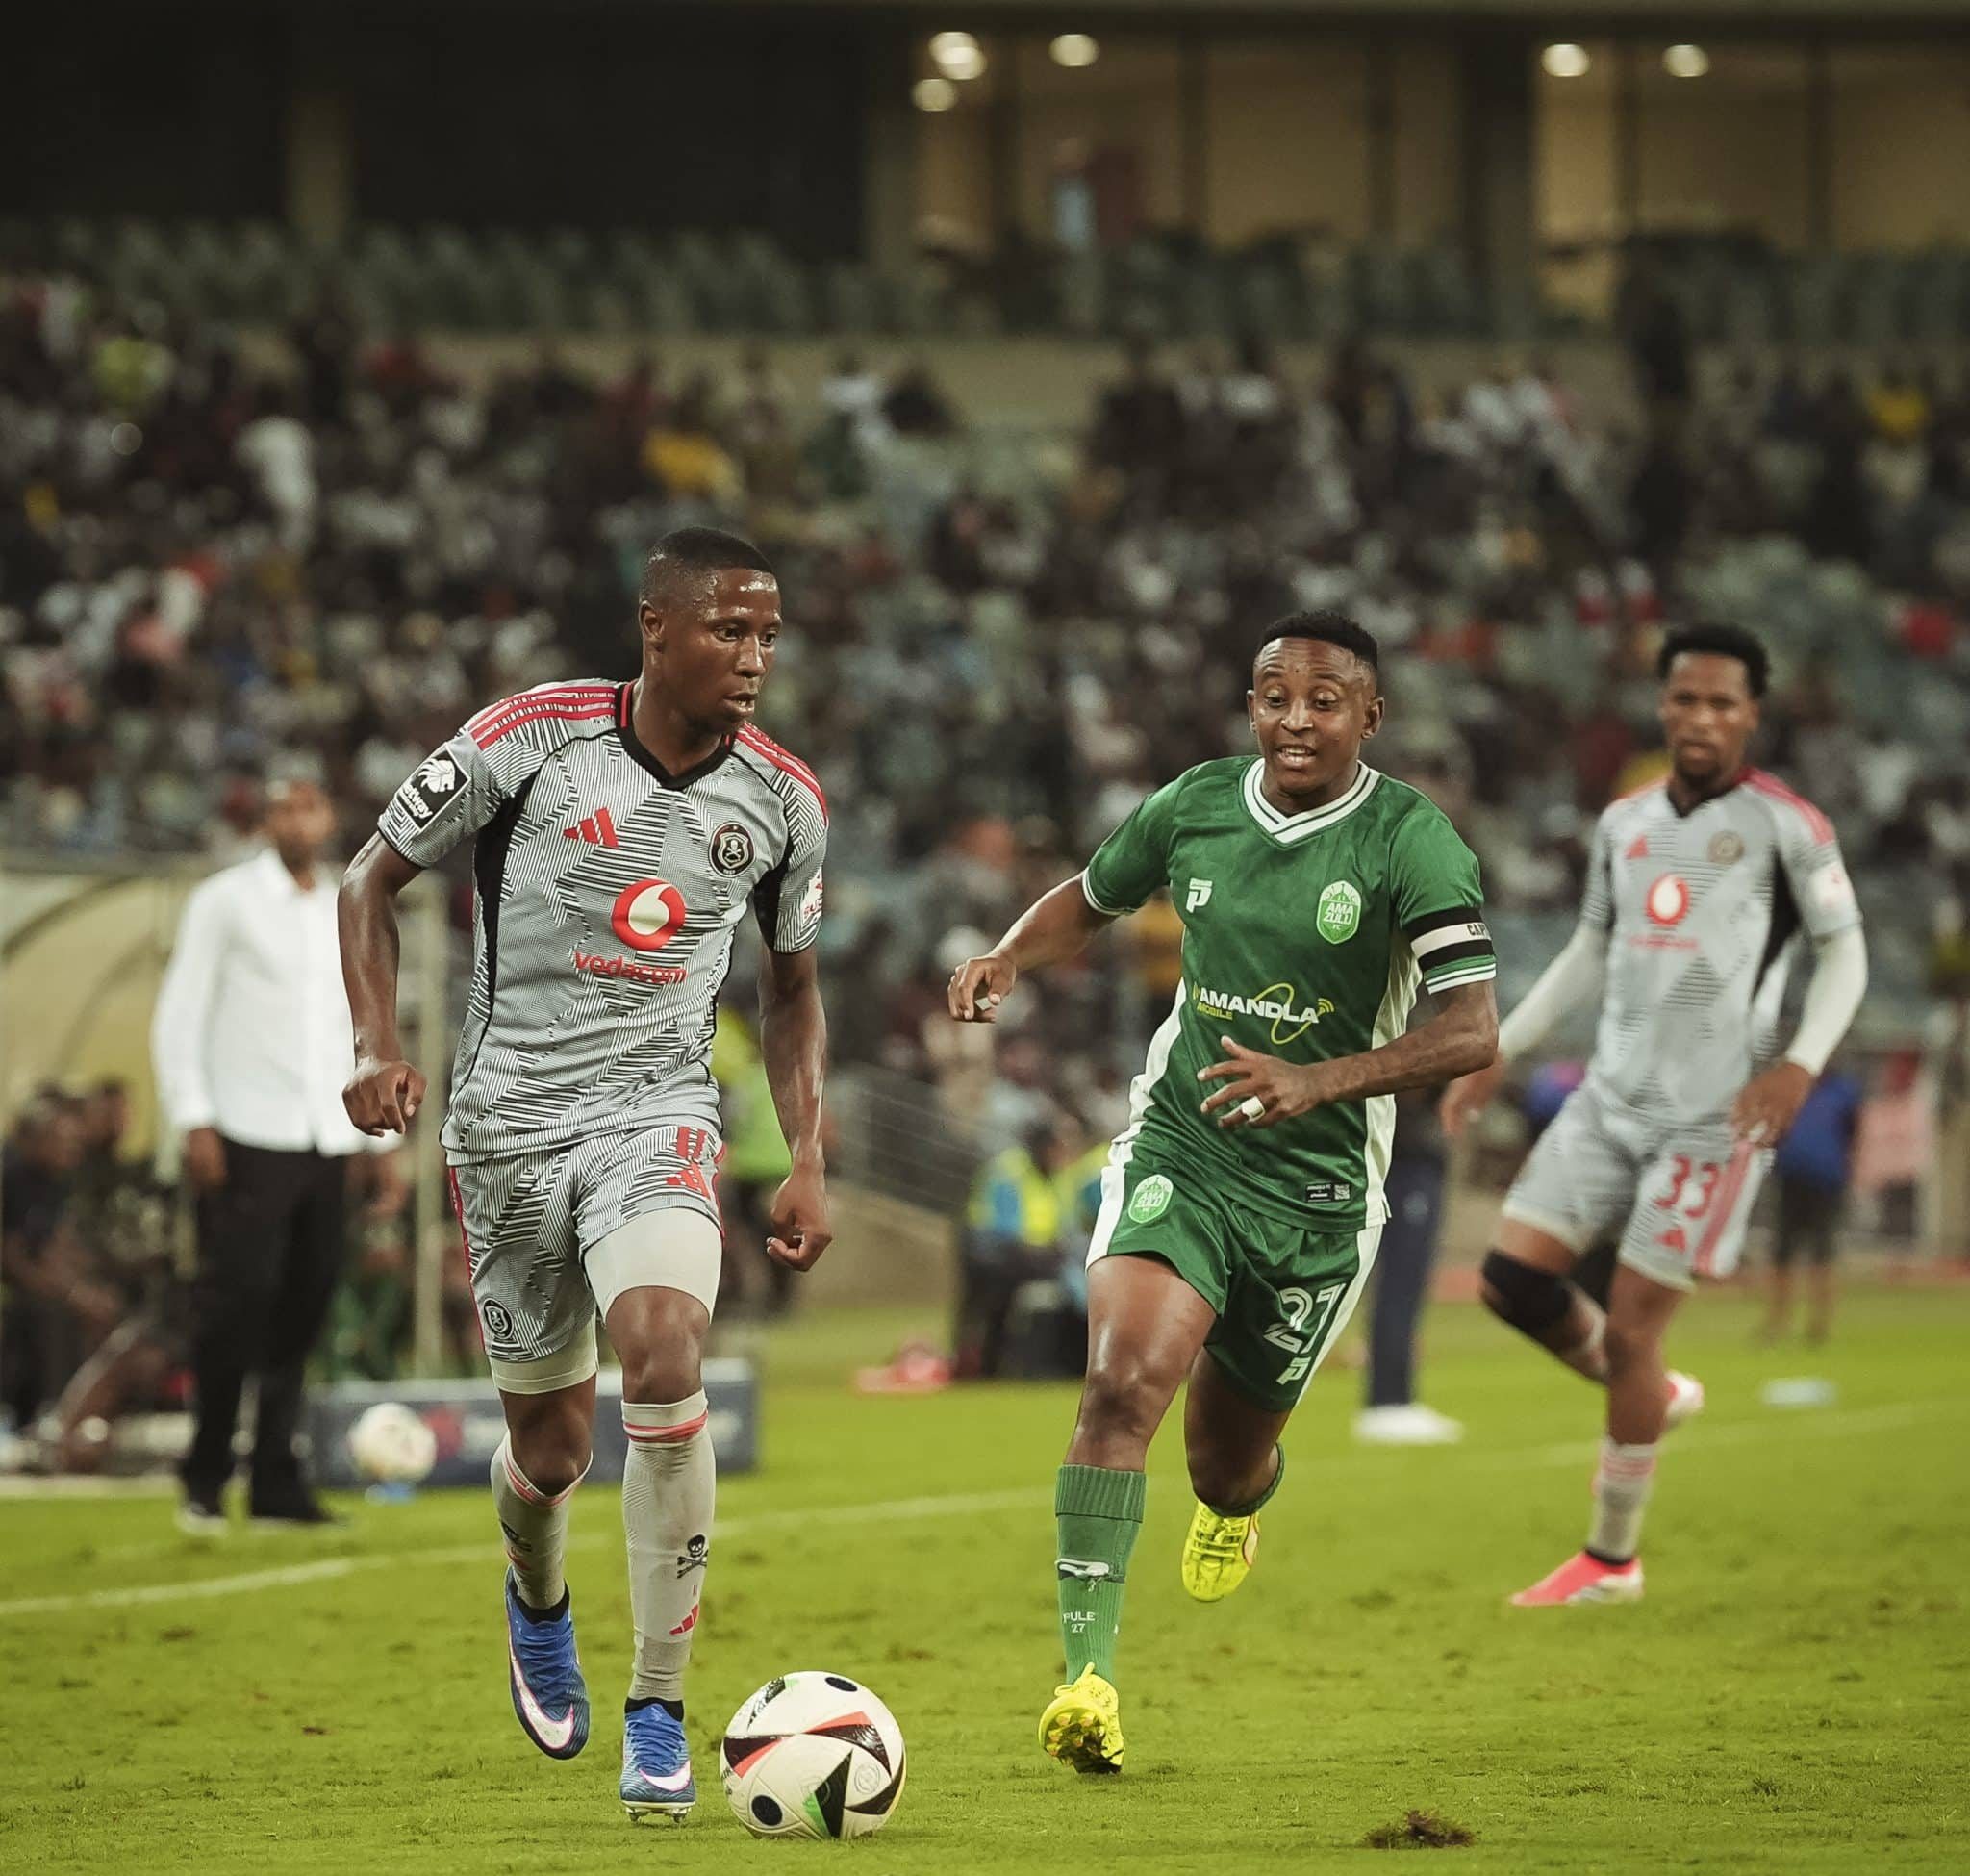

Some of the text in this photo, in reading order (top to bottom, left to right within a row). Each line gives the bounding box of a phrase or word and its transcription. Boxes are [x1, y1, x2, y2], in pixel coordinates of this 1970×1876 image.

[574, 951, 688, 984] vodacom
[1200, 987, 1319, 1024] AMANDLA
[1653, 1155, 1720, 1220] 33
[1263, 1283, 1347, 1355] 27
[1063, 1610, 1096, 1625] PULE
[1071, 1623, 1086, 1634] 27
